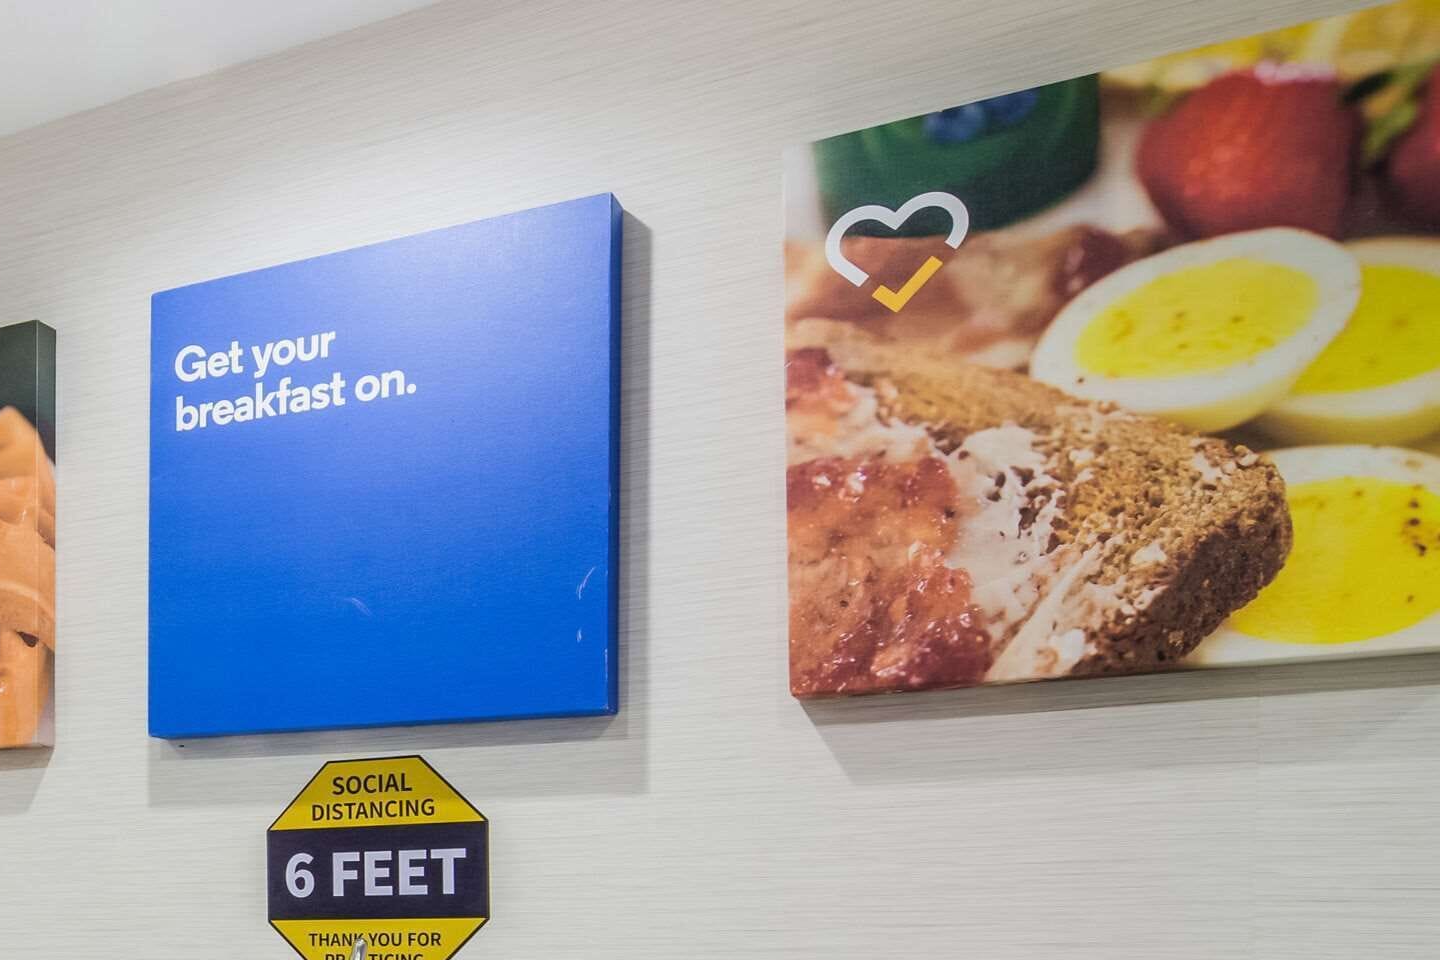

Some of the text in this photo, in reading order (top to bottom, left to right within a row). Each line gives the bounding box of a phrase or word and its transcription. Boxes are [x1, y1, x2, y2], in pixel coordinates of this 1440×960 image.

[175, 331, 336, 382] Get your
[176, 369, 417, 431] breakfast on.
[332, 773, 413, 795] SOCIAL
[312, 798, 435, 821] DISTANCING
[285, 848, 467, 898] 6 FEET
[368, 932, 402, 947] YOU
[407, 932, 442, 947] FOR
